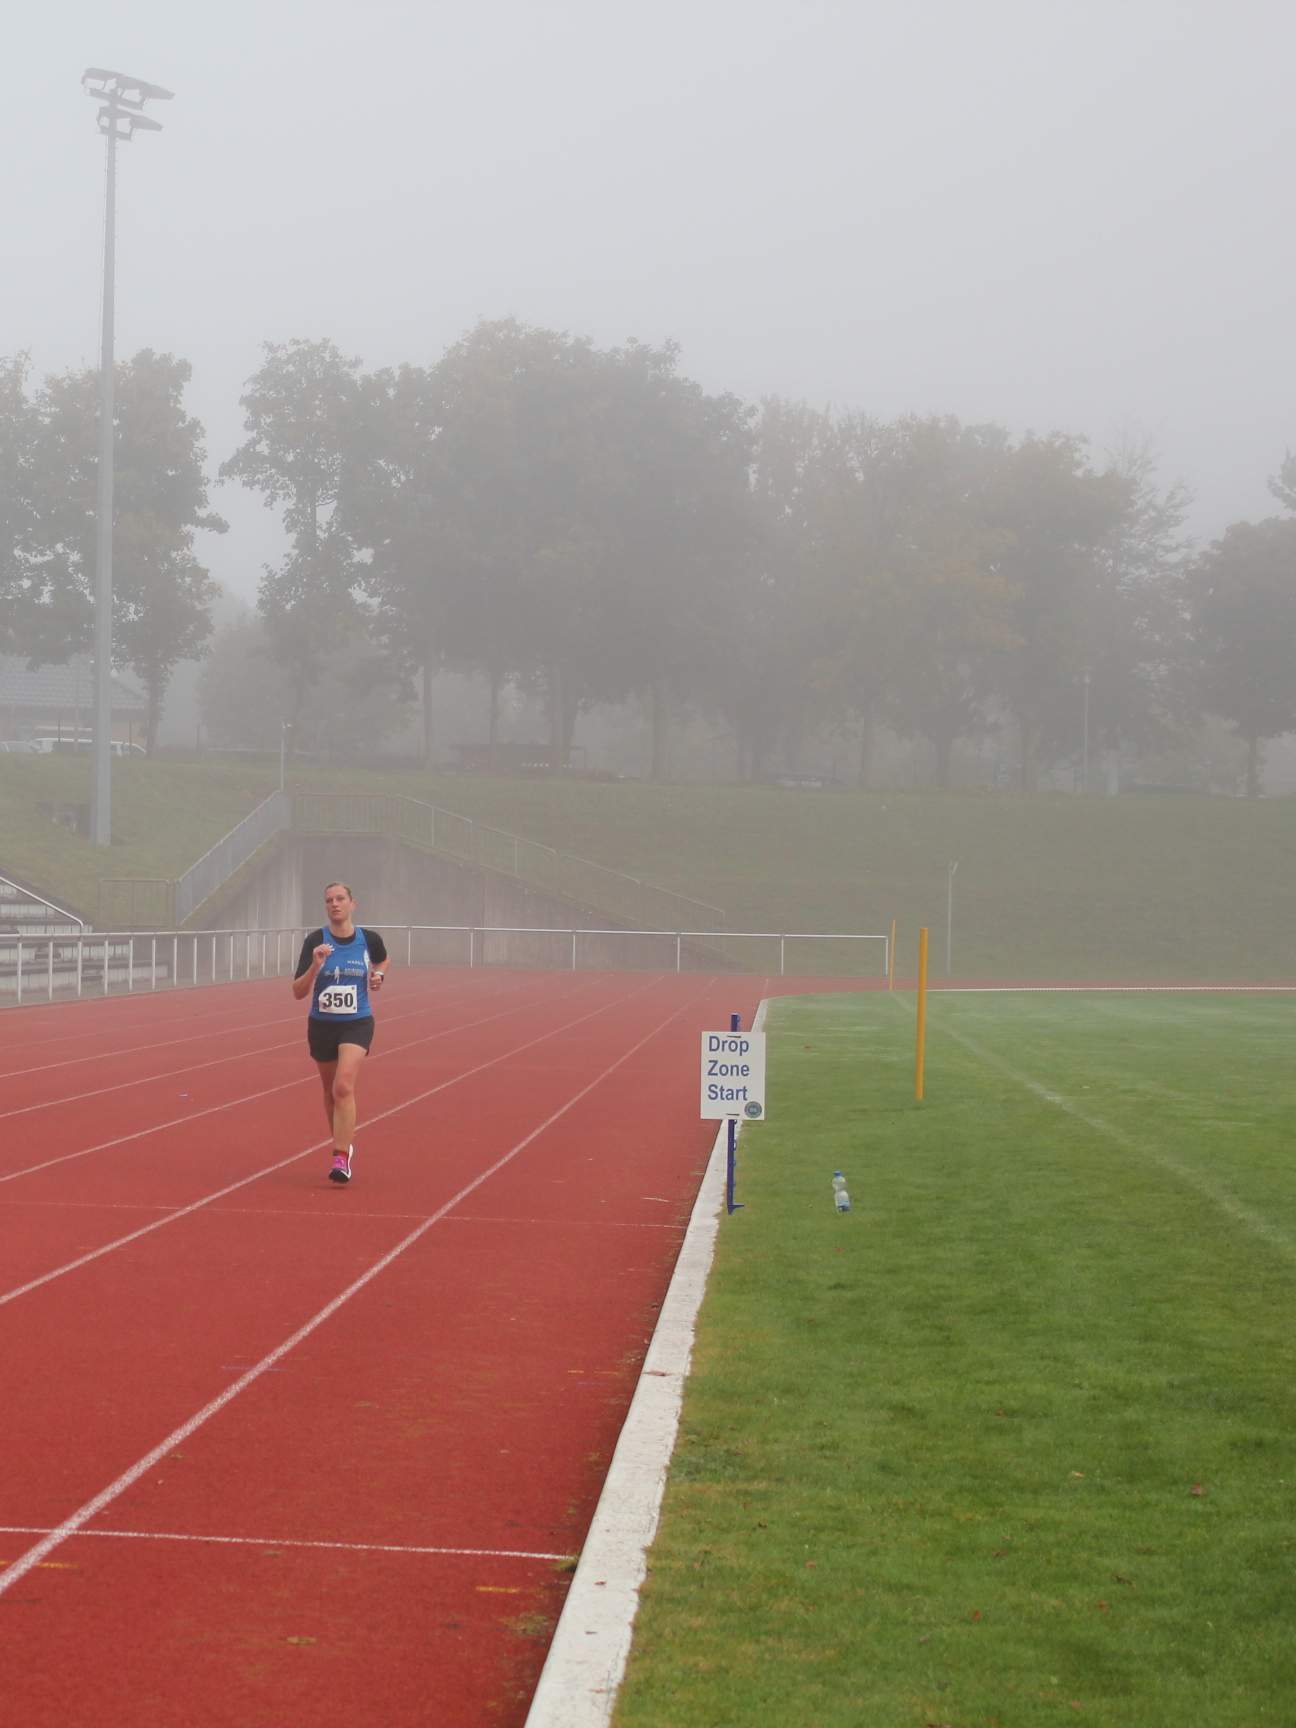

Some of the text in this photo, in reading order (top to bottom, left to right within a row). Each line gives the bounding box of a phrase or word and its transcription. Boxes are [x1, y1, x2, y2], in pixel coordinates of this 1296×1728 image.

[322, 992, 354, 1008] 350
[708, 1035, 750, 1056] Drop
[707, 1060, 750, 1077] Zone
[707, 1083, 748, 1101] Start
